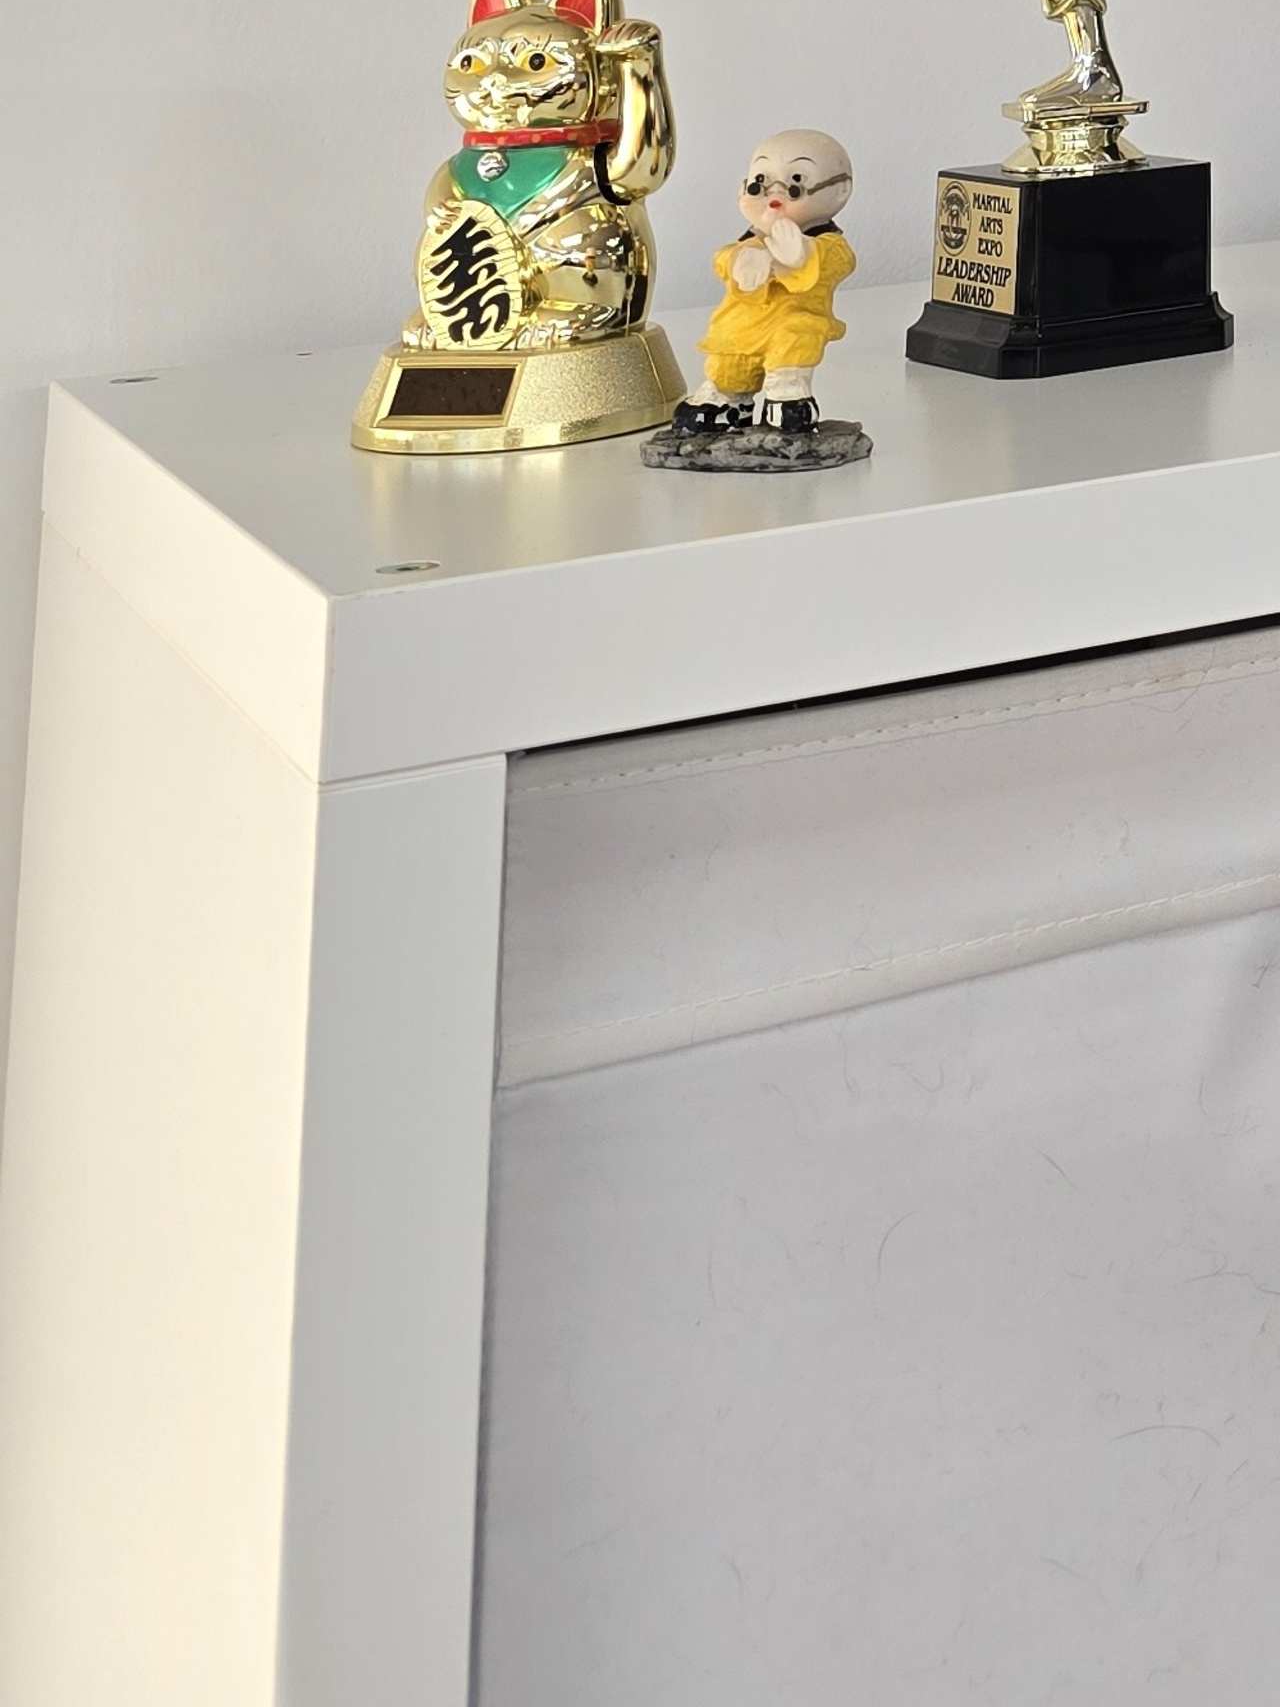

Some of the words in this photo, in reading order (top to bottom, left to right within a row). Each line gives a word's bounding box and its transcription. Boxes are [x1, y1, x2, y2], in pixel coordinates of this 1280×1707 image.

[972, 192, 1013, 215] MARTIAL
[979, 216, 1003, 236] ARTS
[978, 238, 1003, 257] EXPO
[937, 256, 1012, 288] LEADERSHIP
[952, 282, 994, 308] AWARD
